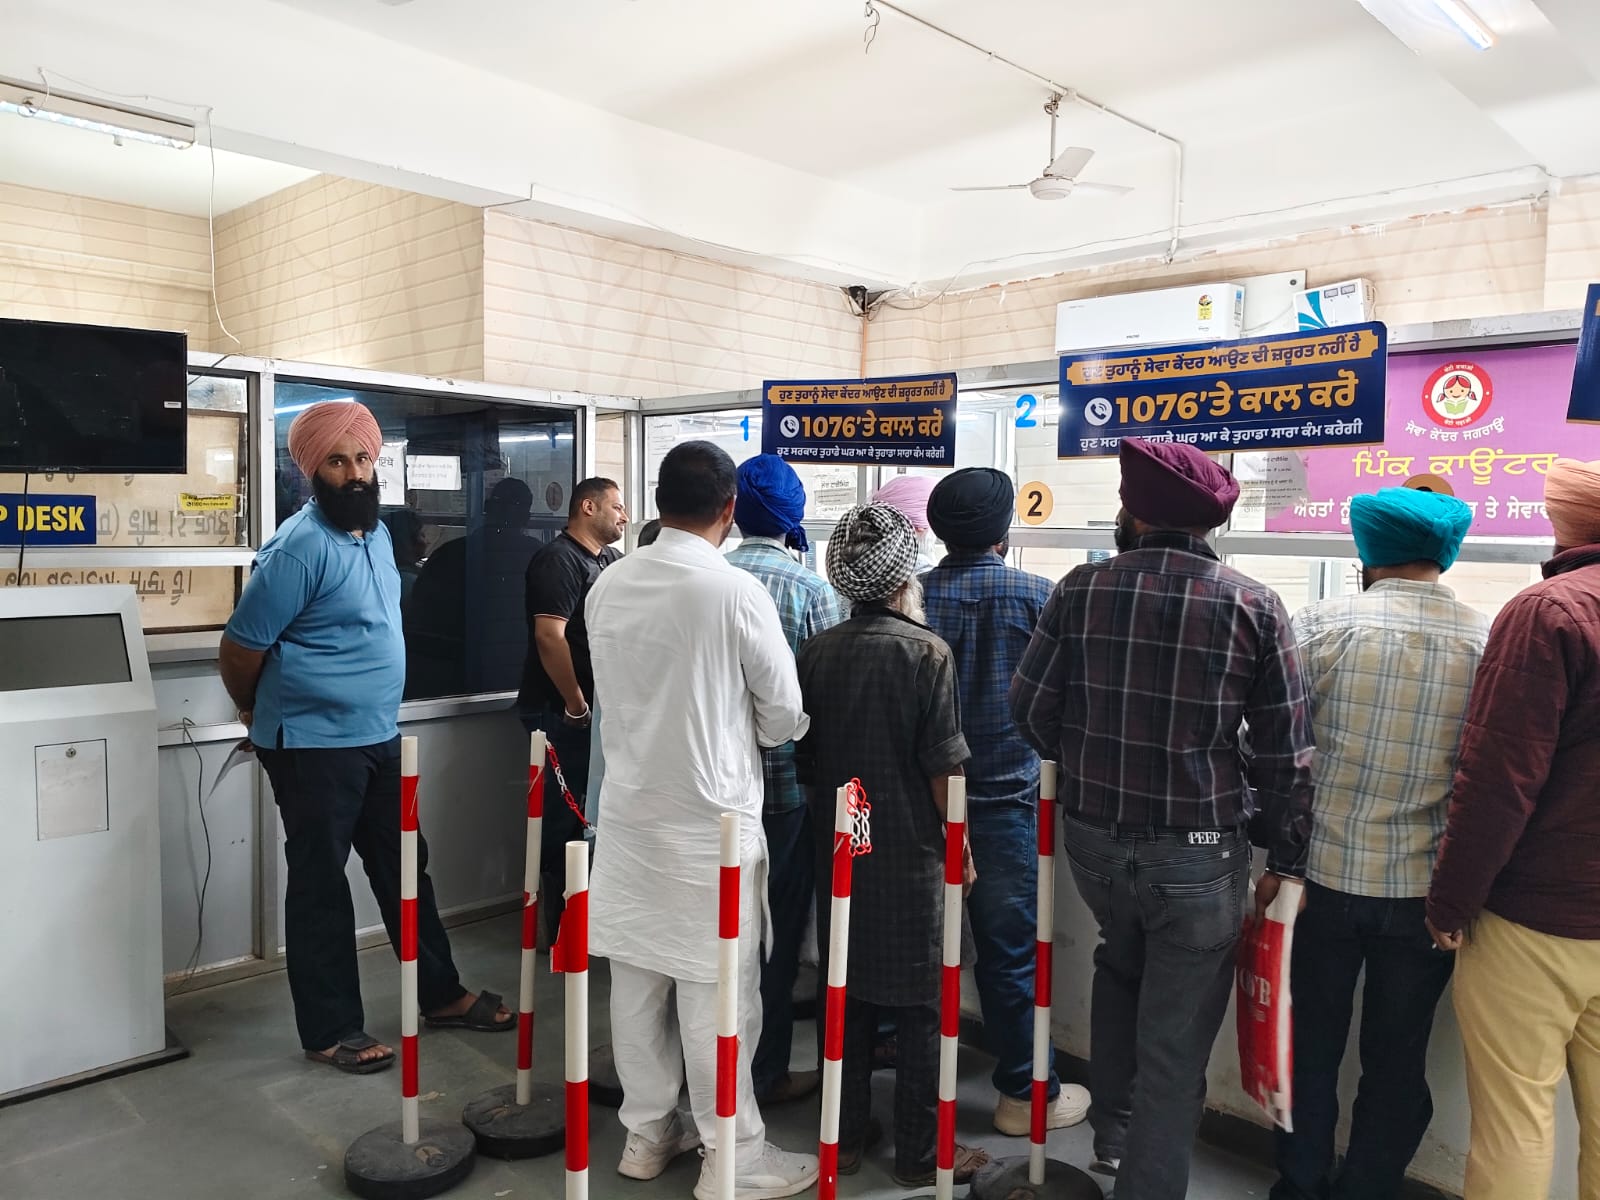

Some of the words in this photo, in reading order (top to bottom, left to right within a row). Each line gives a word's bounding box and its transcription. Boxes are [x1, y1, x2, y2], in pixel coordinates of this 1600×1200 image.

[1082, 366, 1102, 381] ਹੁਣ
[1105, 358, 1141, 380] ਤੁਹਾਨੂੰ
[1144, 357, 1170, 373] ਸੇਵਾ
[1172, 353, 1205, 370] ਕੇਂਦਰ
[1208, 349, 1250, 368] ਆਉਣ
[1252, 344, 1271, 362] ਦੀ
[1318, 333, 1348, 355] ਨਹੀਂ
[1348, 332, 1361, 352] ਹੈ
[779, 390, 793, 402] ਹੁਣ
[795, 386, 820, 404] ਤੁਹਾਨੂੰ
[821, 387, 838, 399] ਸੇਵਾ
[840, 386, 861, 399] ਕੇਂਦਰ
[863, 386, 886, 401] ਆਉਣ
[888, 384, 897, 398] ਦੀ
[924, 381, 939, 396] ਨਹੀਂ
[939, 380, 946, 395] ਹੈ
[1239, 384, 1303, 413] ਕਾਲ
[1308, 369, 1359, 408] ਕਰੋ
[879, 416, 915, 437] ਕਾਲ
[918, 408, 944, 438] ਕਰੋ
[1015, 394, 1037, 427] 2
[740, 416, 749, 441] 1
[1080, 437, 1098, 451] ਹੁਣ
[1176, 432, 1198, 444] ਘਰ
[1200, 430, 1218, 443] ਆ
[1220, 427, 1230, 442] ਕੇ
[1231, 428, 1269, 444] ਤੁਹਾਡਾ
[1270, 426, 1299, 439] ਸਾਰਾ
[1301, 421, 1322, 437] ਕੰਮ
[1324, 417, 1363, 436] ਕਰੇਗੀ
[1405, 420, 1426, 436] ਸੇਵਾ
[776, 446, 790, 458] ਹੁਣ
[791, 447, 818, 457] ਸਰਕਾਰ
[819, 445, 840, 459] ਤੁਹਾਡੇ
[841, 448, 855, 457] ਘਰ
[856, 448, 866, 457] ਆ
[867, 445, 874, 457] ਕੇ
[875, 448, 897, 460] ਤੁਹਾਡਾ
[897, 448, 912, 458] ਸਾਰਾ
[913, 446, 925, 458] ਕੰਮ
[1352, 449, 1415, 478] ਪਿੰਕ
[1428, 447, 1559, 485] ਕਾਊਂਟਰ
[1027, 490, 1043, 517] 2
[1485, 495, 1499, 519] ਤੇ
[17, 505, 85, 531] DESK
[1188, 831, 1220, 844] PEEP
